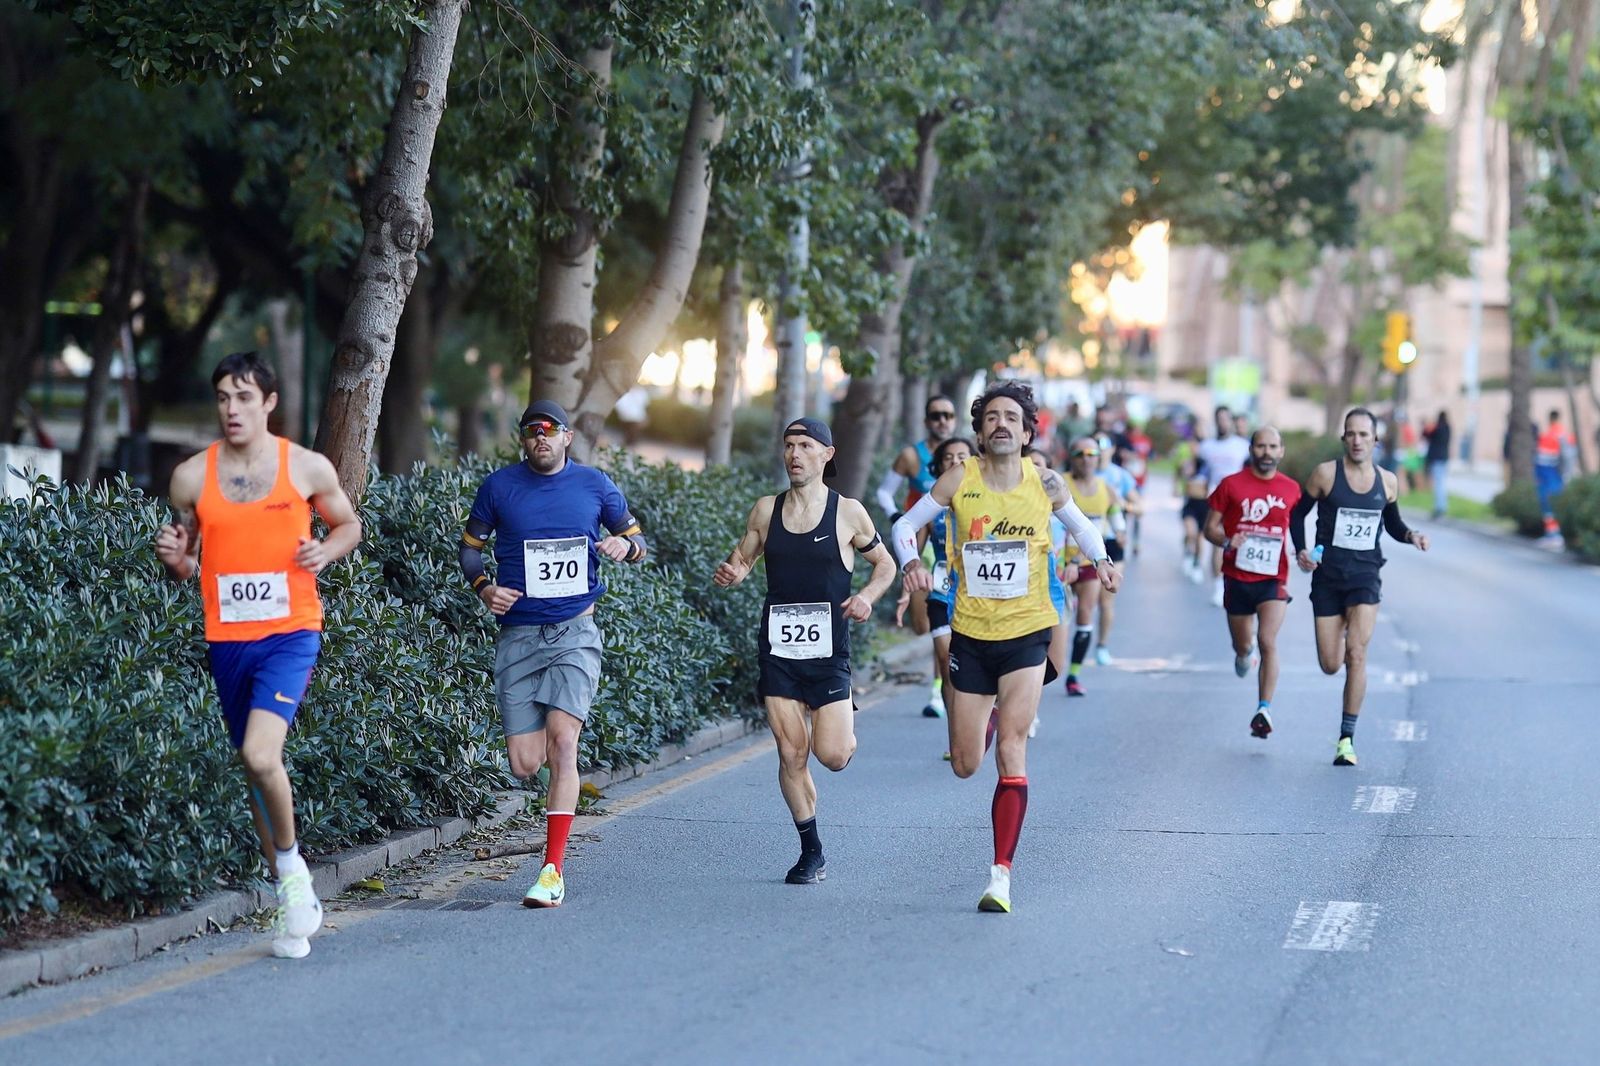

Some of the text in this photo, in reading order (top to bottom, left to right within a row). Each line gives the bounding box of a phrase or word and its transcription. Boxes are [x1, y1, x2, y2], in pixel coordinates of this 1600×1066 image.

[991, 517, 1035, 536] Álora
[1344, 524, 1371, 538] 324
[1246, 547, 1272, 562] 841
[538, 560, 578, 581] 370
[977, 562, 1016, 581] 447
[231, 581, 272, 602] 602
[781, 624, 820, 643] 526
